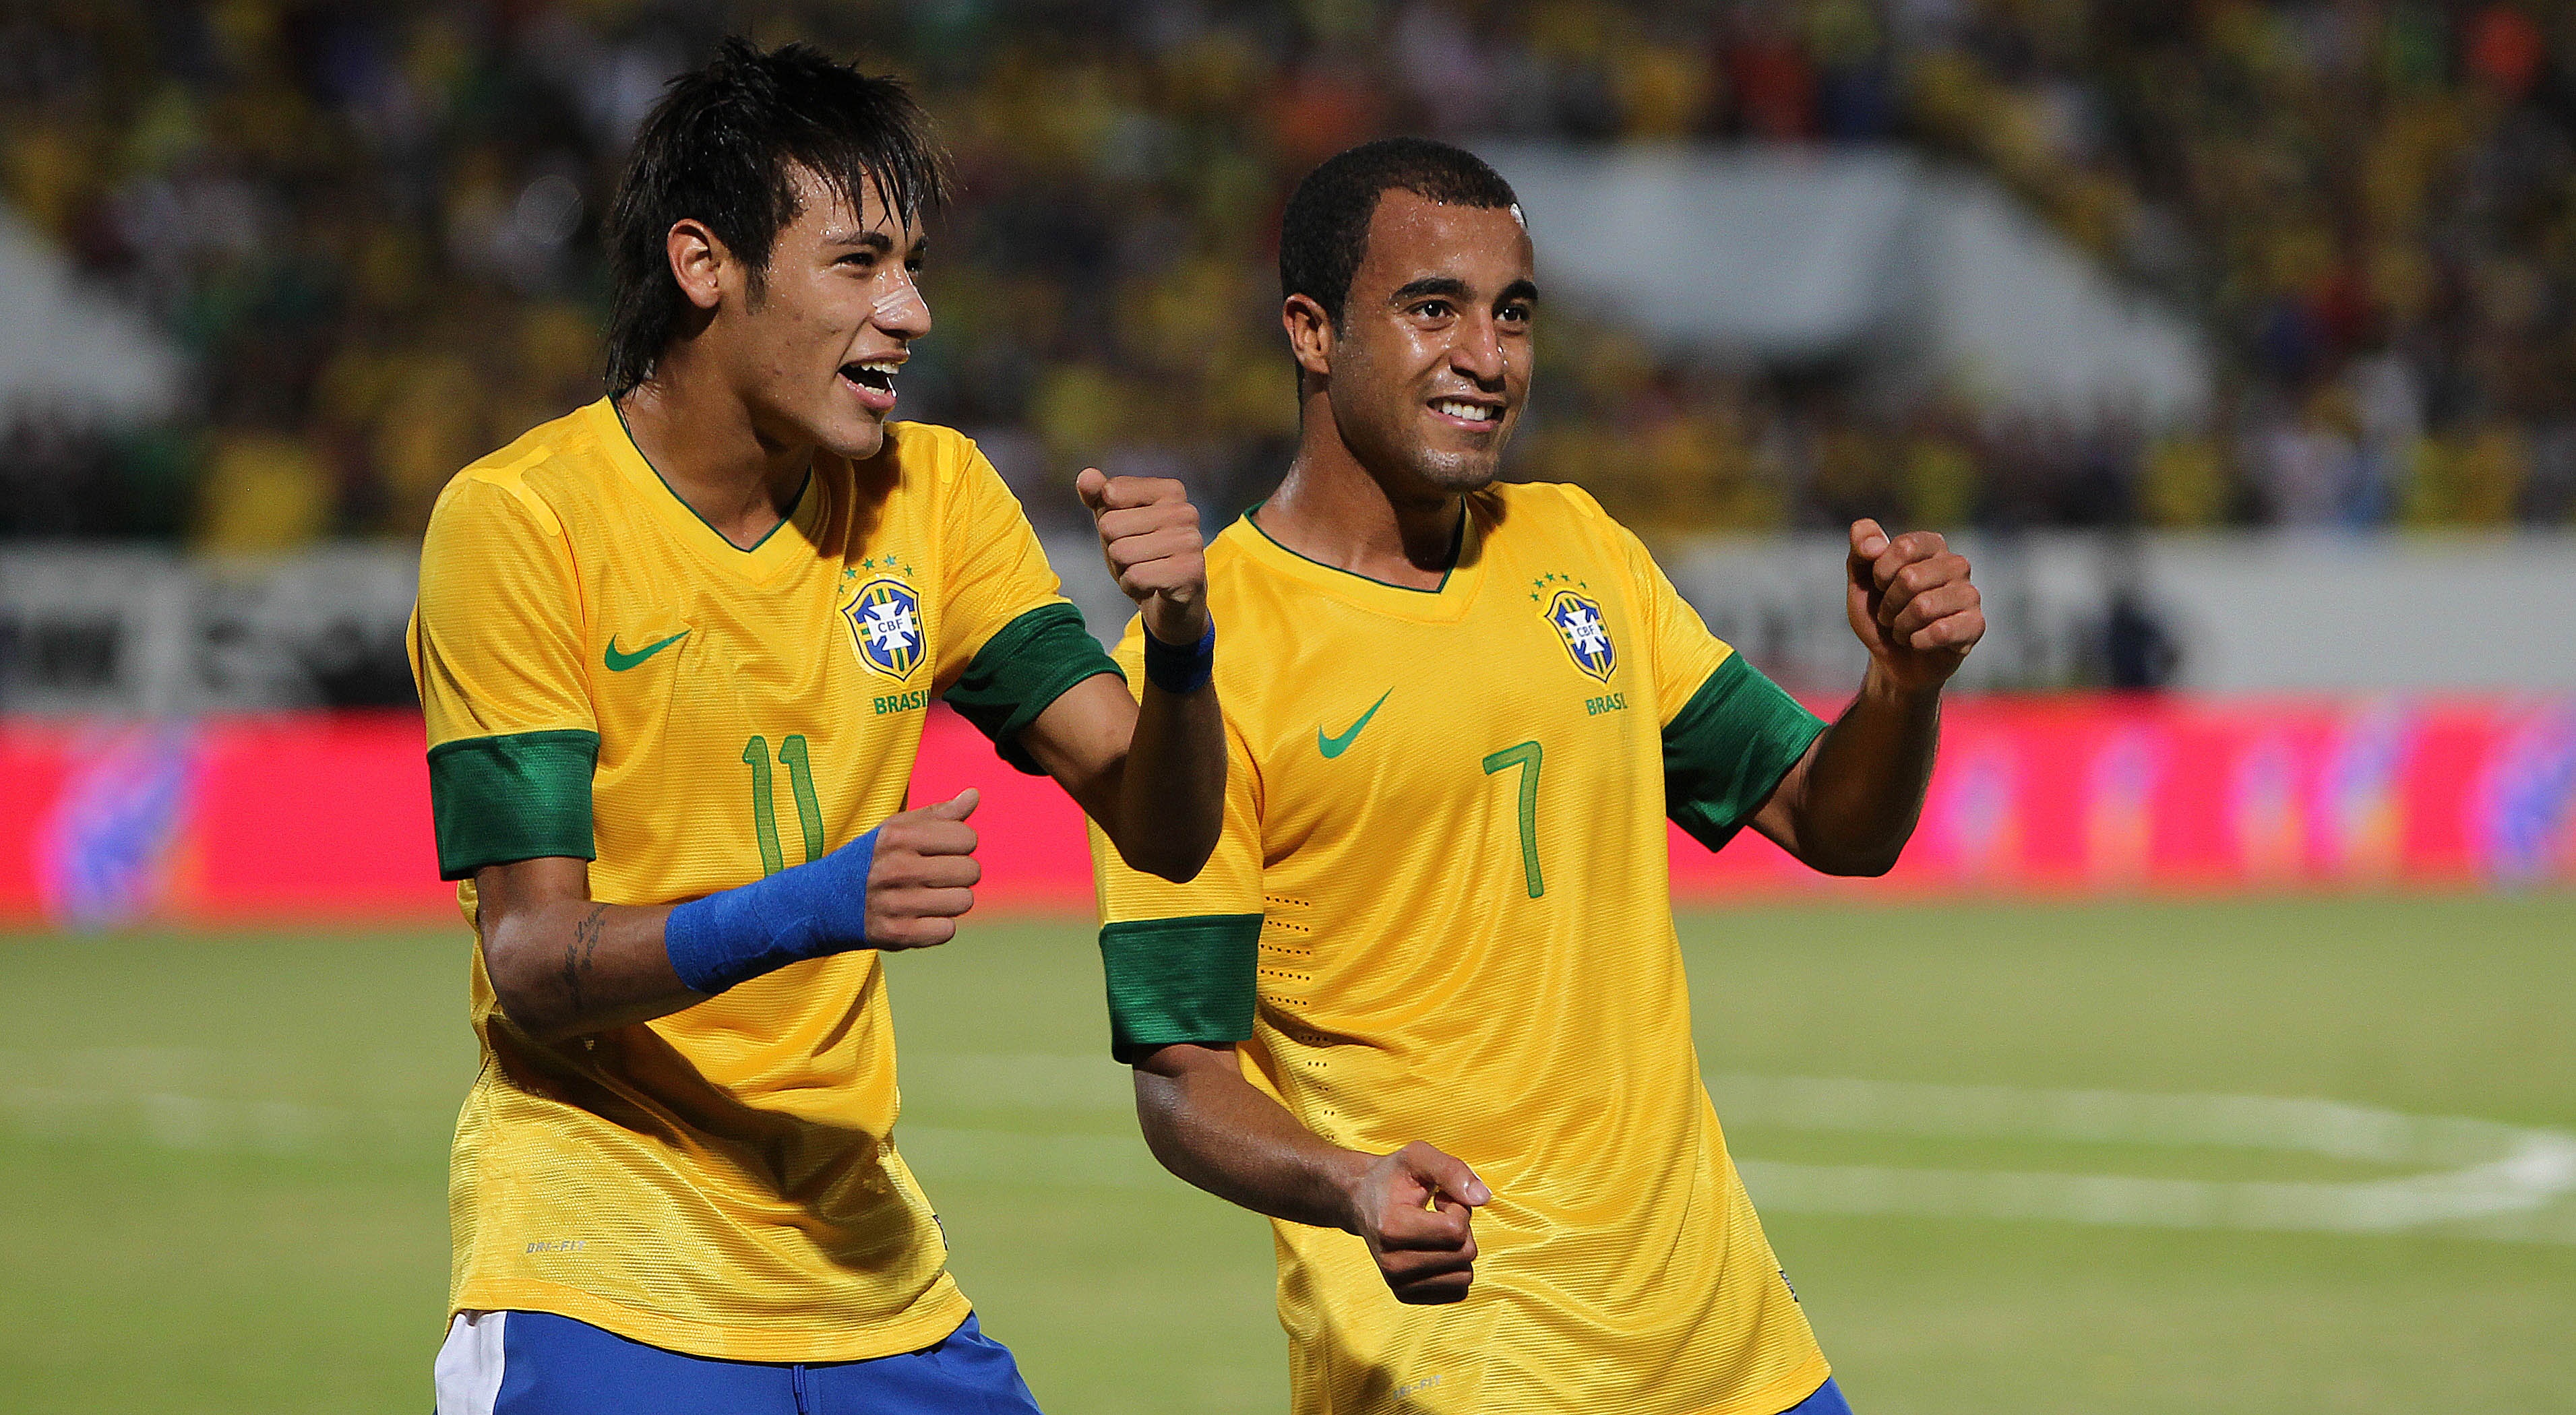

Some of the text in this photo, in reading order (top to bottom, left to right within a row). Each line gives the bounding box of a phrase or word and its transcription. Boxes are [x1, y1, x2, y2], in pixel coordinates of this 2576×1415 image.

[878, 619, 904, 633] CBF
[1576, 625, 1595, 637] CBF
[743, 734, 824, 878] 11
[1482, 741, 1543, 898] 7
[526, 1240, 586, 1253] DRI-FIT
